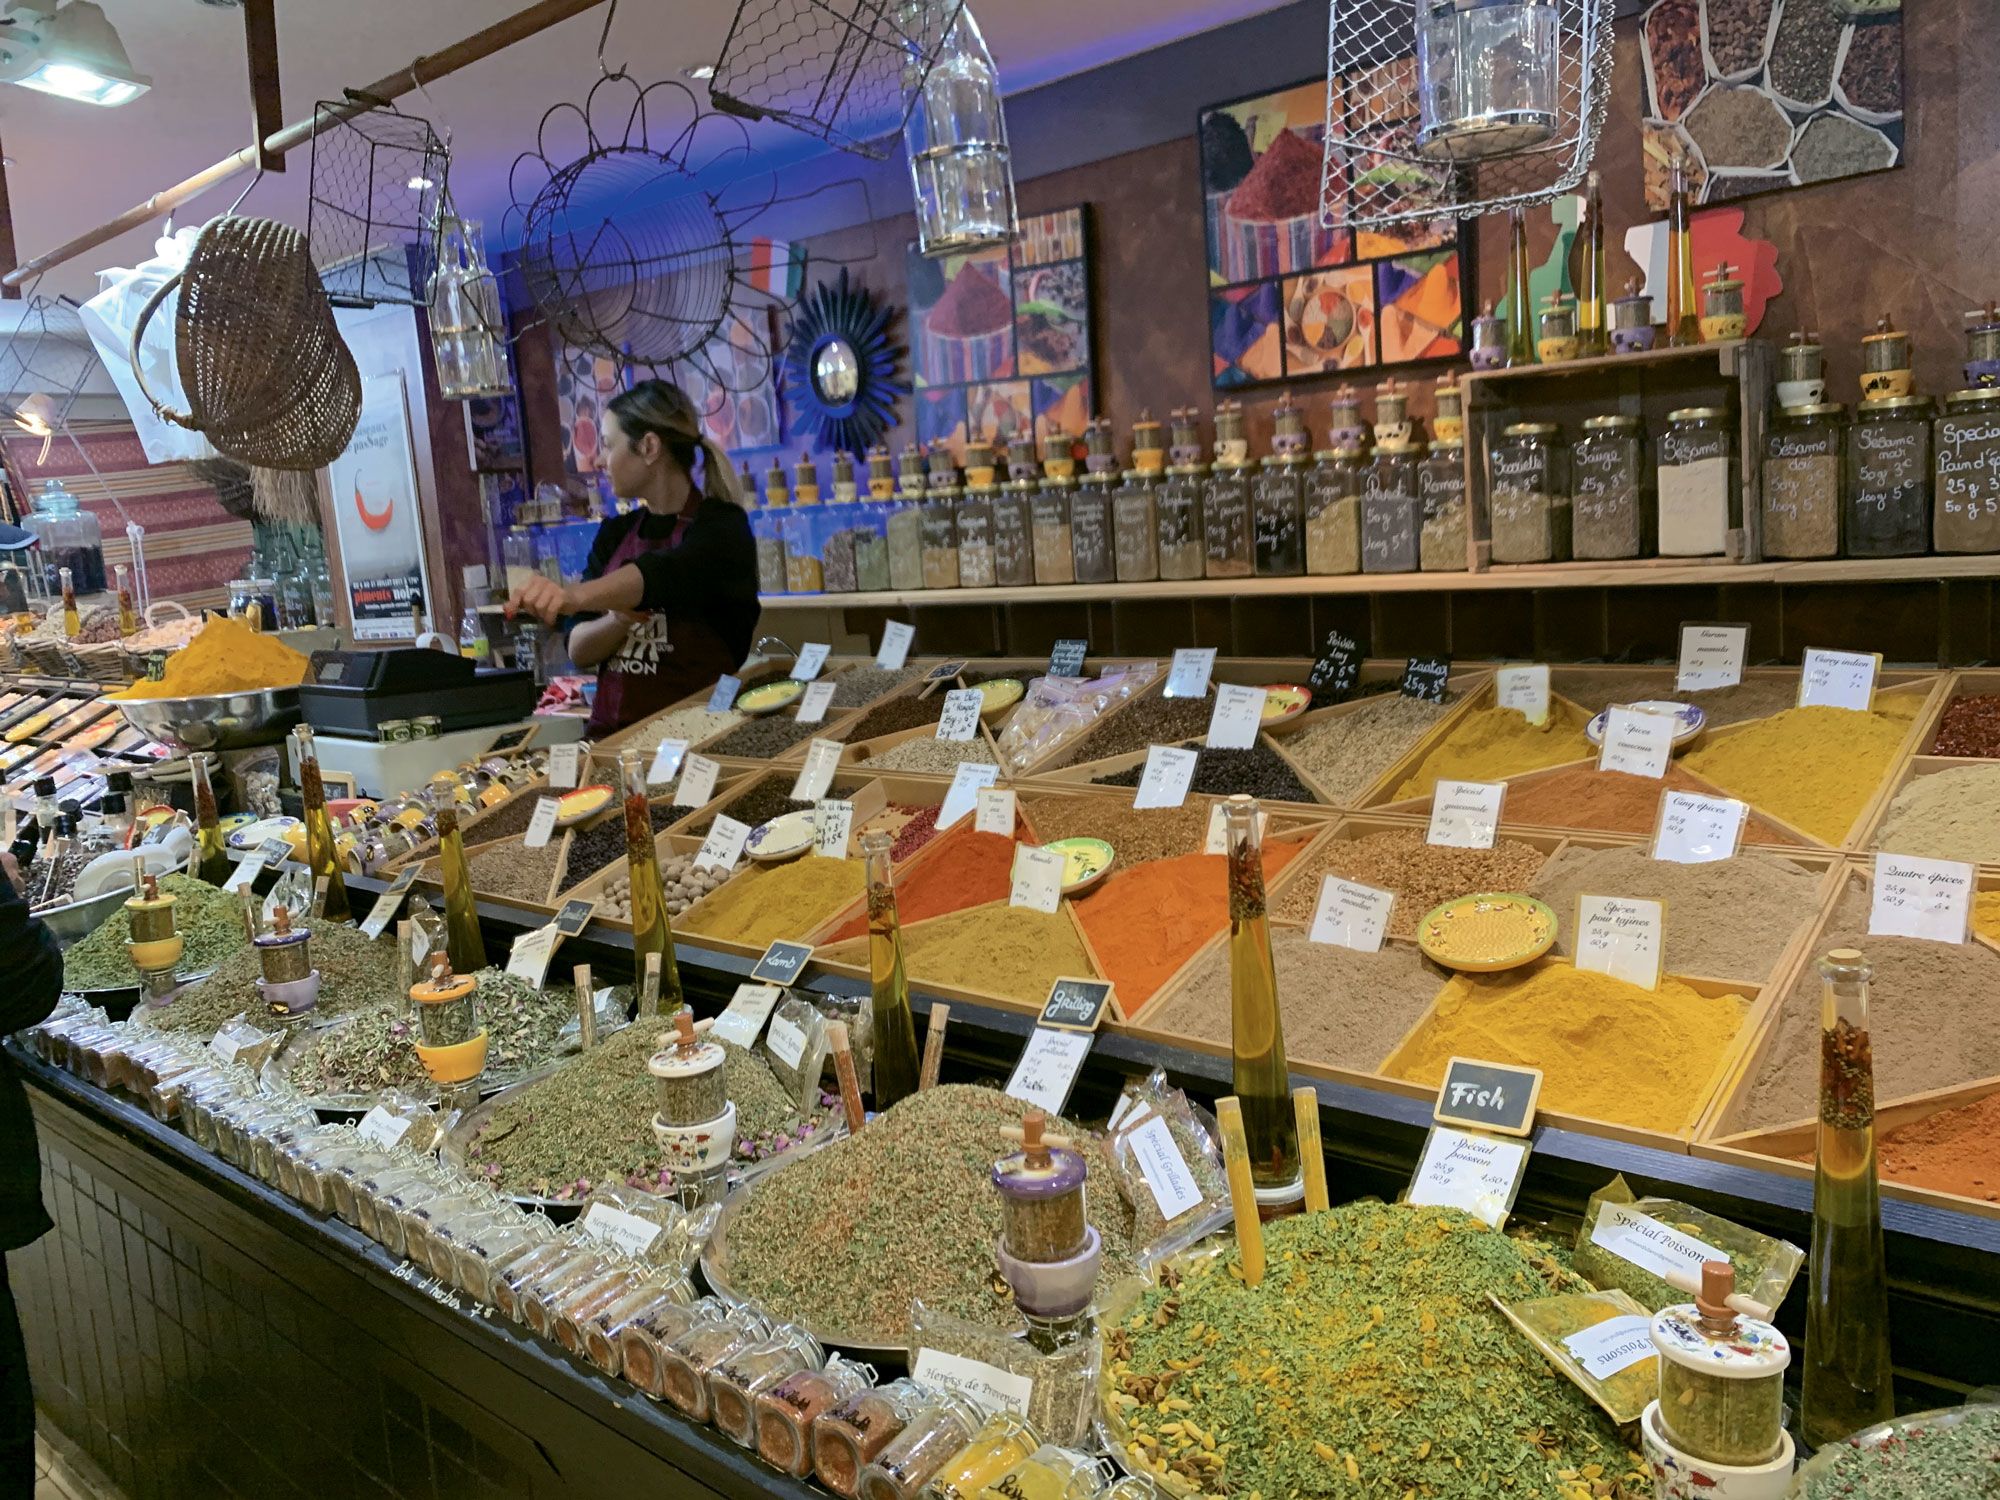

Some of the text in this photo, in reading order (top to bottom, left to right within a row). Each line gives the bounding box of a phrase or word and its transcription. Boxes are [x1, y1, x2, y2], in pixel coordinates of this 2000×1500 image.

[353, 586, 392, 609] piments
[1672, 796, 1728, 815] Cinq épices
[1884, 865, 1966, 885] Quatre épices
[1587, 913, 1650, 928] pour tajines
[766, 950, 797, 969] Lamb
[1450, 1082, 1505, 1111] Fish
[1452, 1137, 1498, 1156] Spécial
[1444, 1146, 1492, 1168] poisson
[1612, 1210, 1660, 1244] Spécial
[1597, 1339, 1650, 1366] Poissons
[964, 1378, 979, 1391] de
